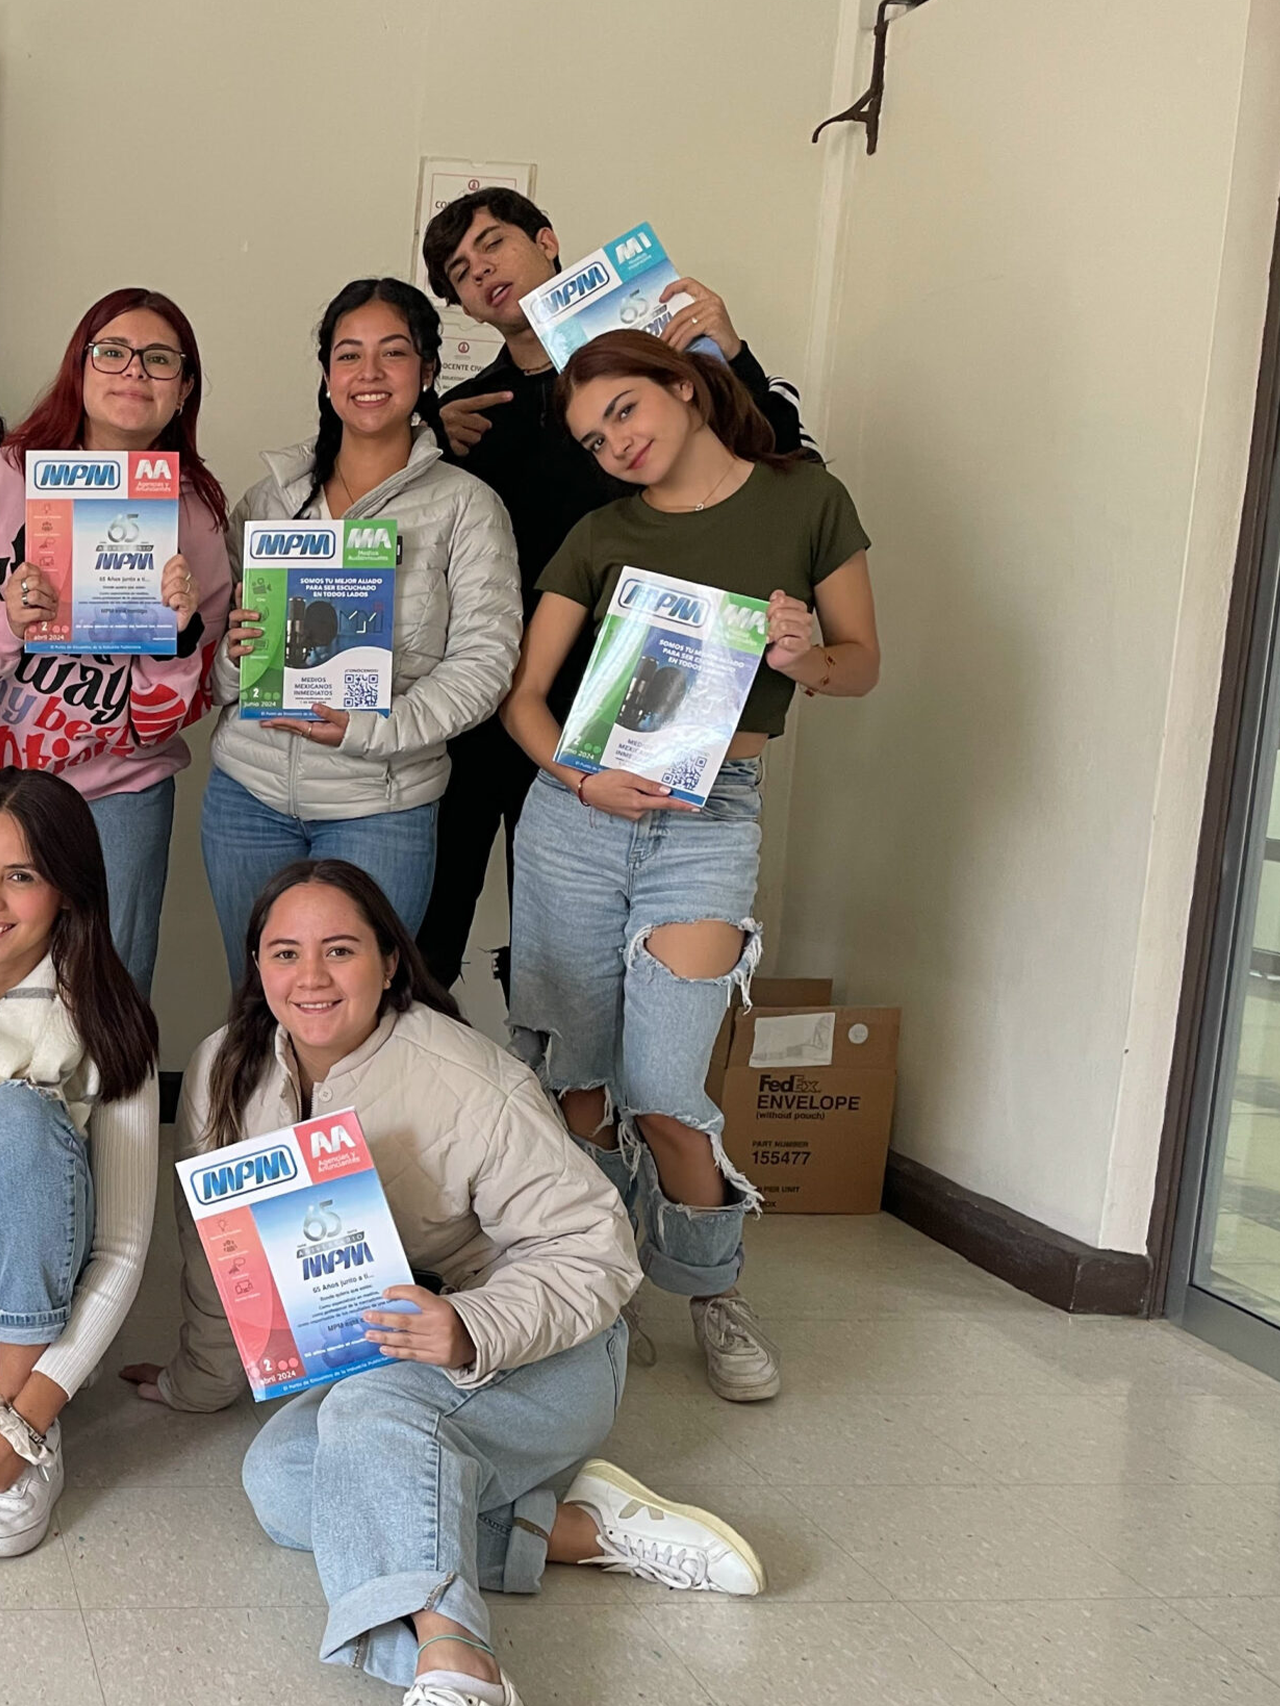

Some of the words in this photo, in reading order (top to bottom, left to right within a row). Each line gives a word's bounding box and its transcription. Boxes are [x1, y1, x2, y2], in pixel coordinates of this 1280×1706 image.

[615, 232, 652, 264] MI
[542, 265, 605, 314] MPM
[621, 289, 649, 324] 65
[40, 464, 115, 486] MPM
[135, 459, 171, 479] AA
[108, 514, 139, 543] 65
[256, 534, 330, 555] MPM
[346, 528, 392, 548] MA
[95, 553, 154, 570] MPM
[624, 584, 704, 623] MPM
[42, 622, 47, 631] 2
[34, 633, 47, 641] abril
[659, 639, 684, 652] SOMOS
[685, 646, 694, 654] TU
[663, 648, 680, 658] PARA
[681, 653, 693, 662] SER
[679, 659, 702, 671] TODOS
[15, 654, 128, 725] way
[253, 688, 259, 698] 2
[574, 736, 581, 745] 2
[578, 750, 594, 760] 2024
[759, 1074, 820, 1093] FedEx
[757, 1095, 861, 1111] ENVELOPE
[757, 1112, 792, 1120] (without
[794, 1112, 825, 1120] pouch)
[310, 1125, 356, 1159] AA
[318, 1156, 360, 1172] Anunciantes
[319, 1153, 350, 1167] Agencias
[350, 1151, 355, 1159] y
[752, 1151, 811, 1165] 155477
[203, 1150, 291, 1201] MPM
[303, 1199, 341, 1242] 65
[303, 1242, 375, 1280] MPM
[322, 1281, 339, 1292] Años
[340, 1276, 357, 1288] junto
[327, 1322, 344, 1332] MPM
[263, 1359, 272, 1371] 2
[260, 1375, 276, 1385] abril
[277, 1370, 296, 1381] 2024
